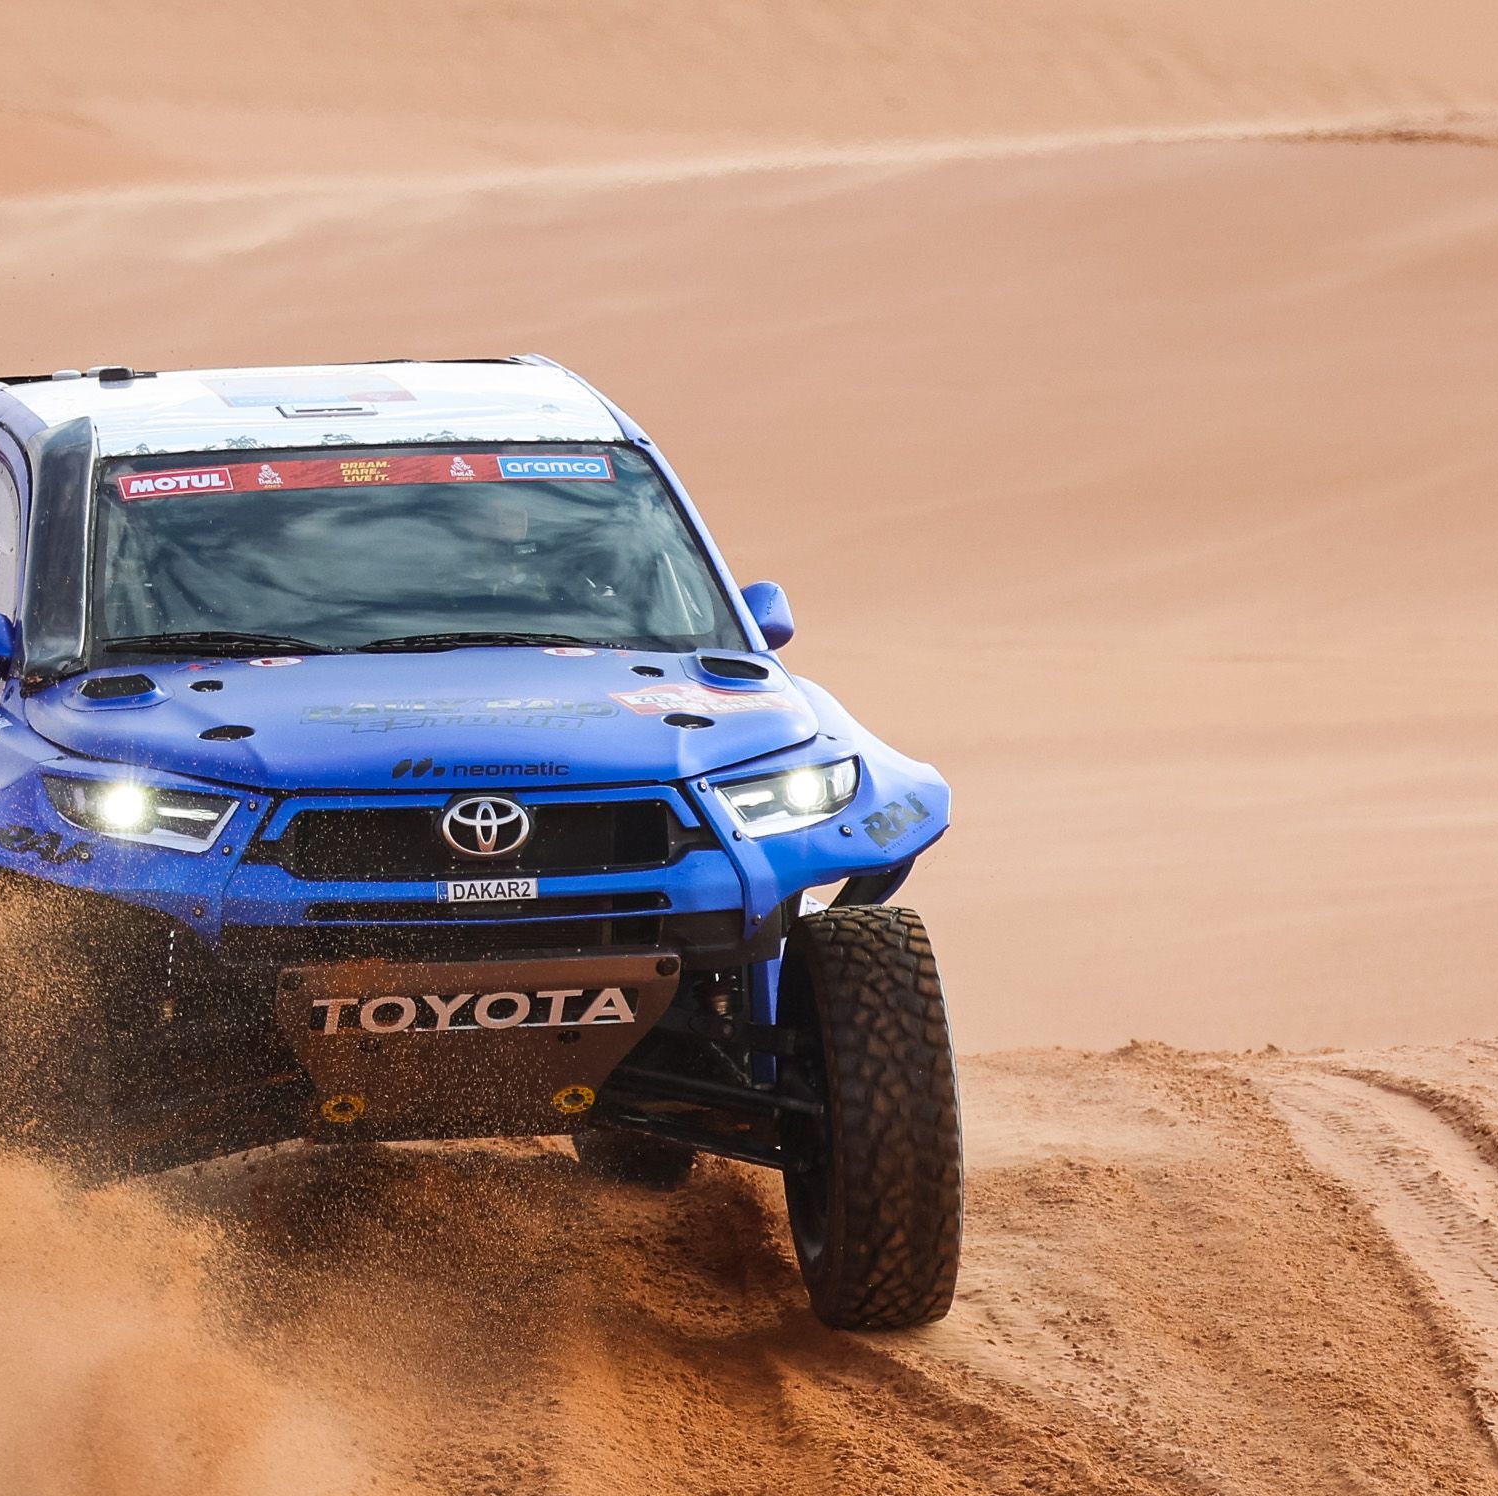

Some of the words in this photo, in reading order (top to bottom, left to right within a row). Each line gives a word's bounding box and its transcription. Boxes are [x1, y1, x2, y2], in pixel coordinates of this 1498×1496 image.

[340, 461, 391, 470] DREAM.
[506, 462, 601, 473] aramco
[341, 468, 381, 477] DARE.
[343, 474, 373, 483] LIVE
[374, 473, 390, 481] IT.
[129, 473, 225, 494] MOTUL
[453, 761, 570, 777] neomatic
[453, 881, 531, 900] DAKAR2
[312, 987, 636, 1036] TOYOTA
